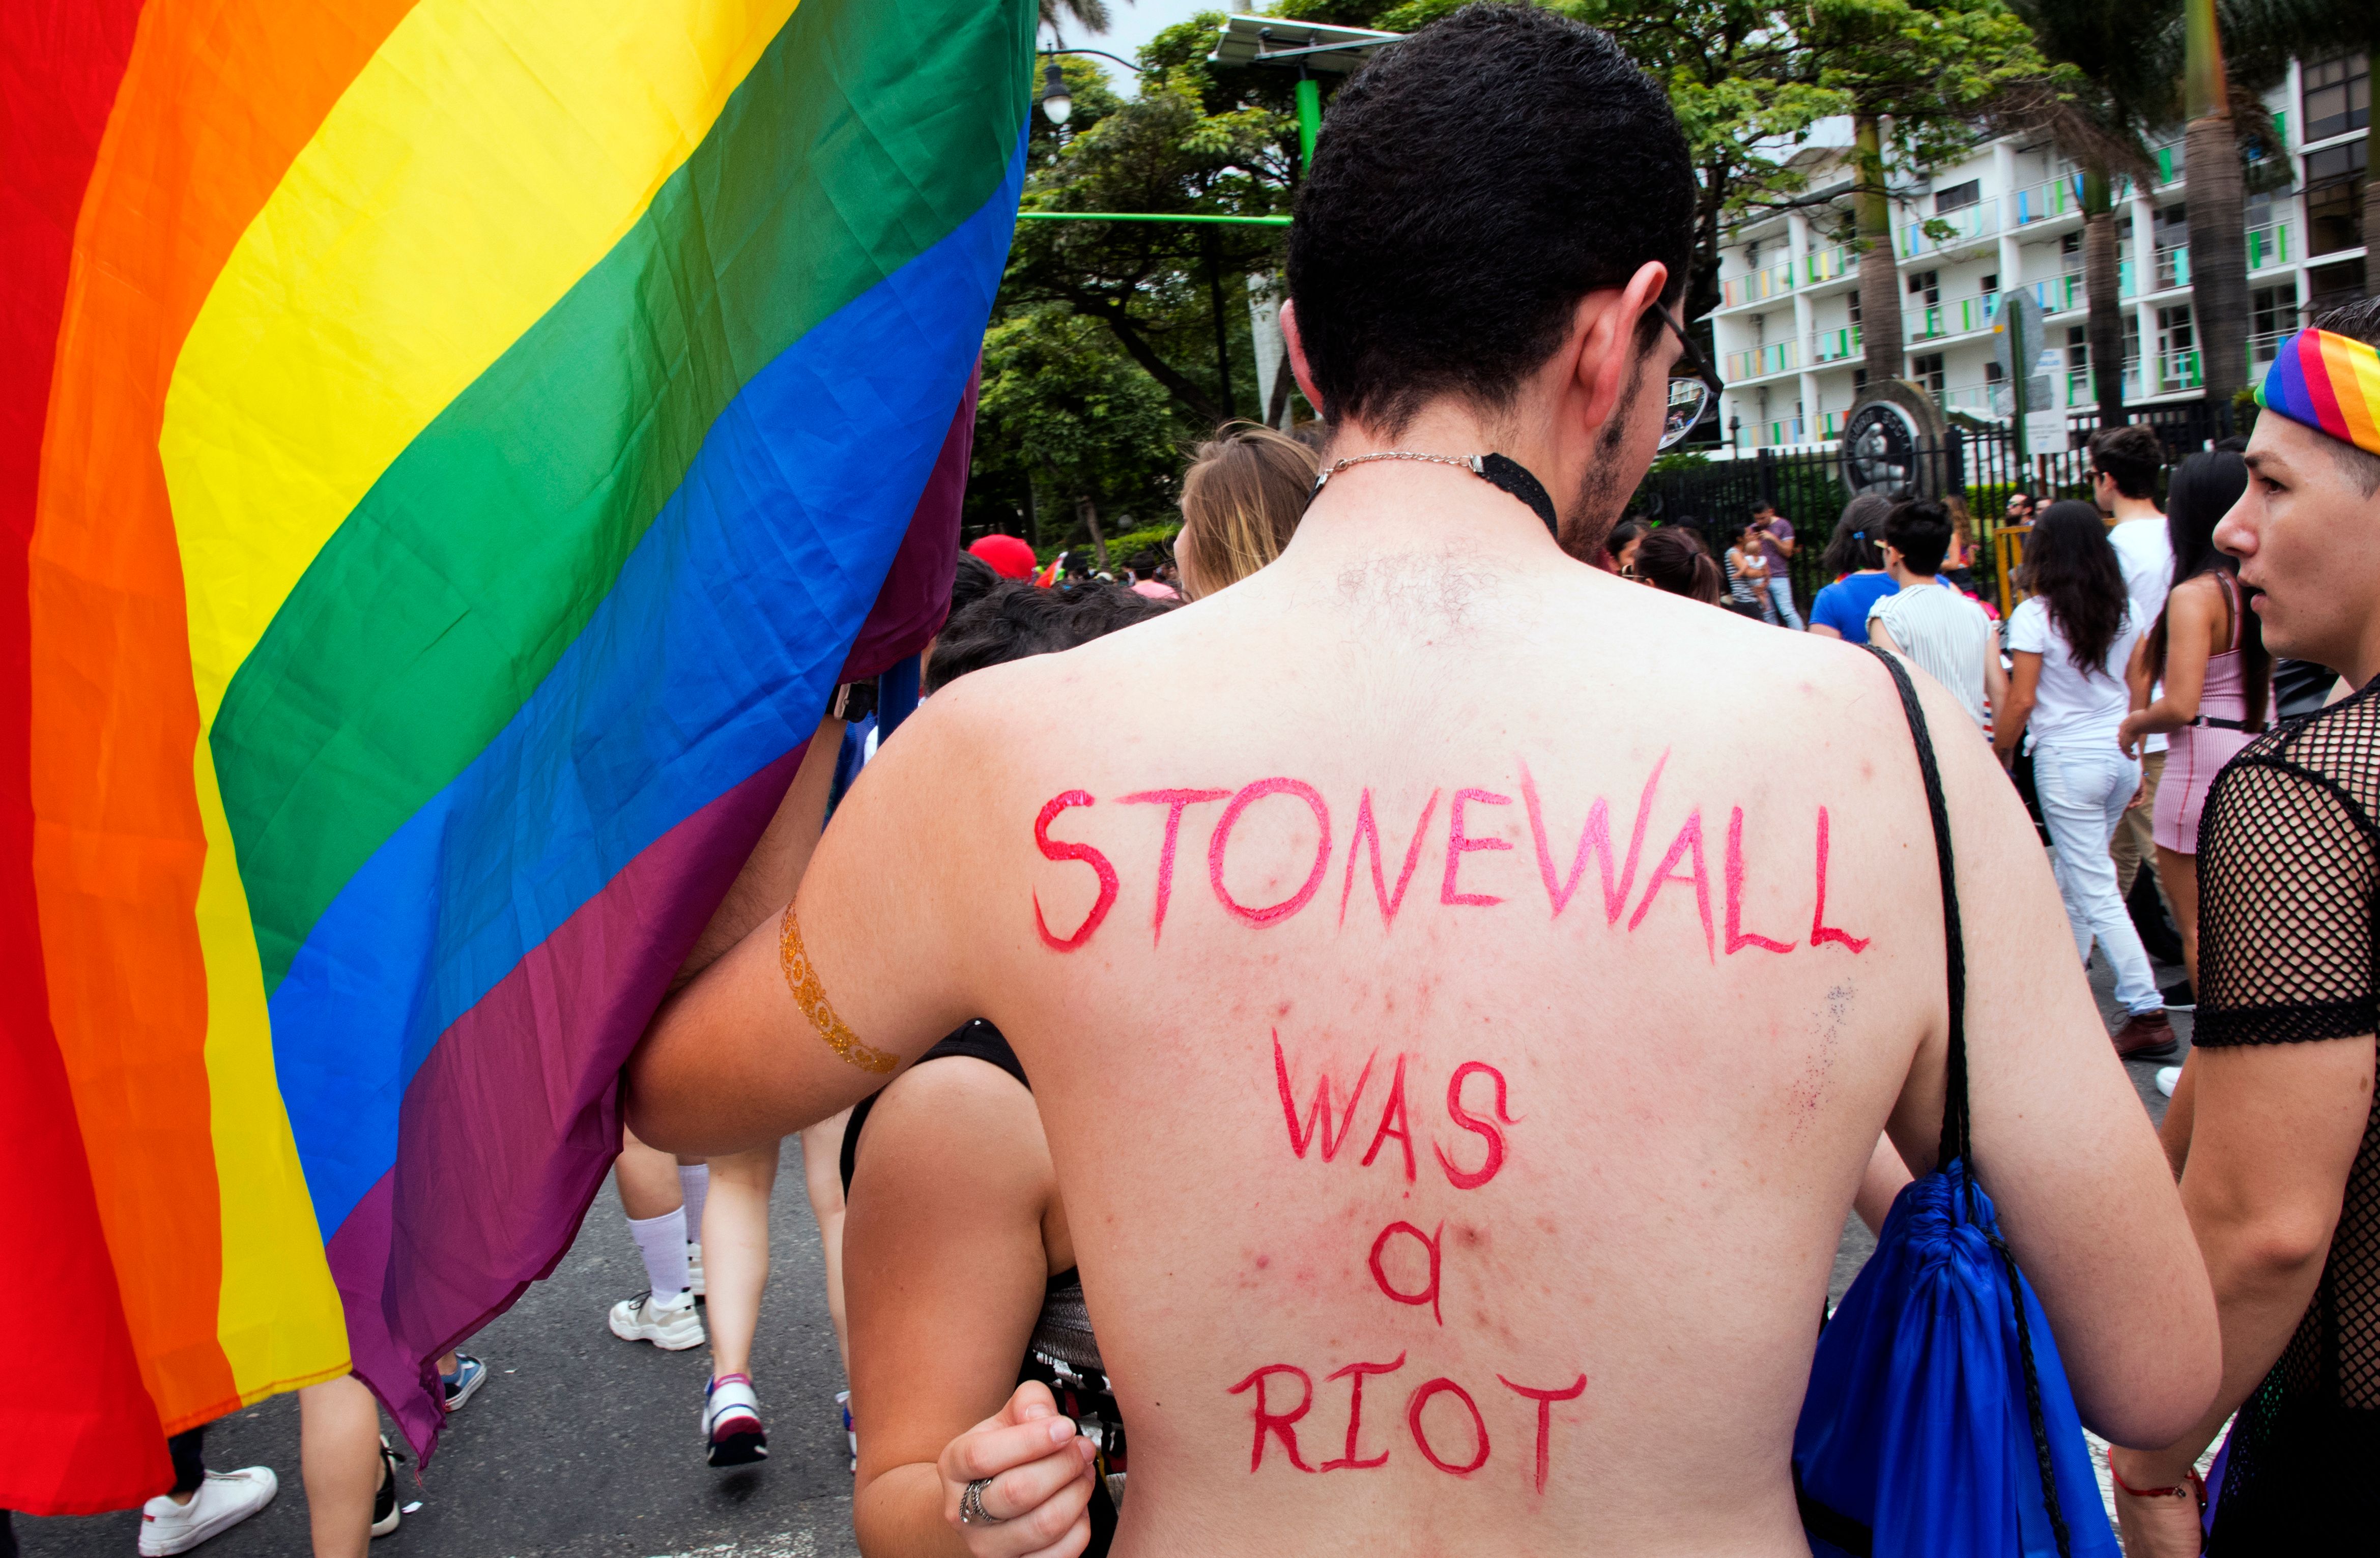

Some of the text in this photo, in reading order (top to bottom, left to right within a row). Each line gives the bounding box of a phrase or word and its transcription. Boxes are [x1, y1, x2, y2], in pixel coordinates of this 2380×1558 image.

[1033, 746, 1871, 965] STONEWALL
[1271, 1026, 1527, 1190] WAS
[1367, 1220, 1444, 1326] a
[1227, 1350, 1588, 1495] RIOT
